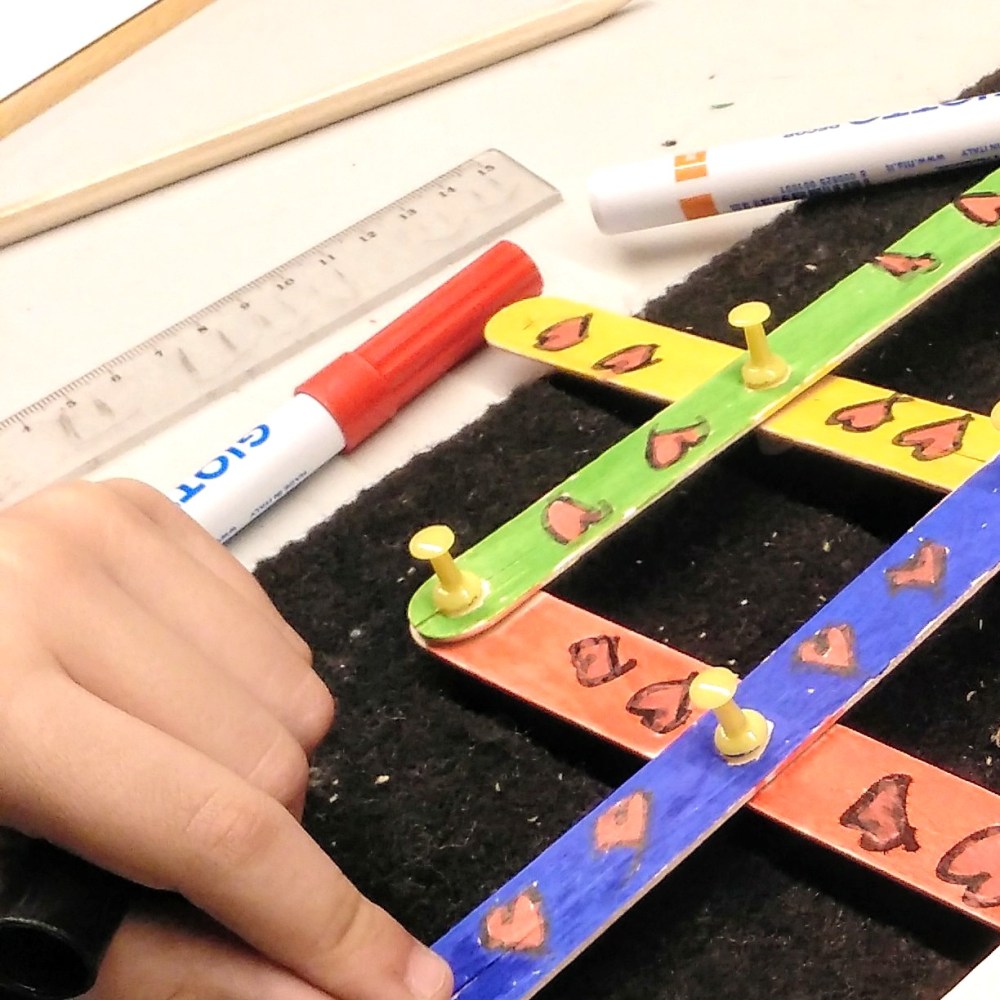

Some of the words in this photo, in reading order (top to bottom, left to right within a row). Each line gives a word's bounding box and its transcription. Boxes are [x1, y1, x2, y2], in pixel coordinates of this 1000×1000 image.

[961, 144, 988, 157] ITALY
[276, 278, 295, 290] 10
[319, 254, 335, 265] 11
[359, 230, 377, 242] 12
[399, 208, 417, 220] 13
[438, 186, 456, 197] 14
[477, 164, 495, 176] 15
[174, 424, 271, 508] GIOT
